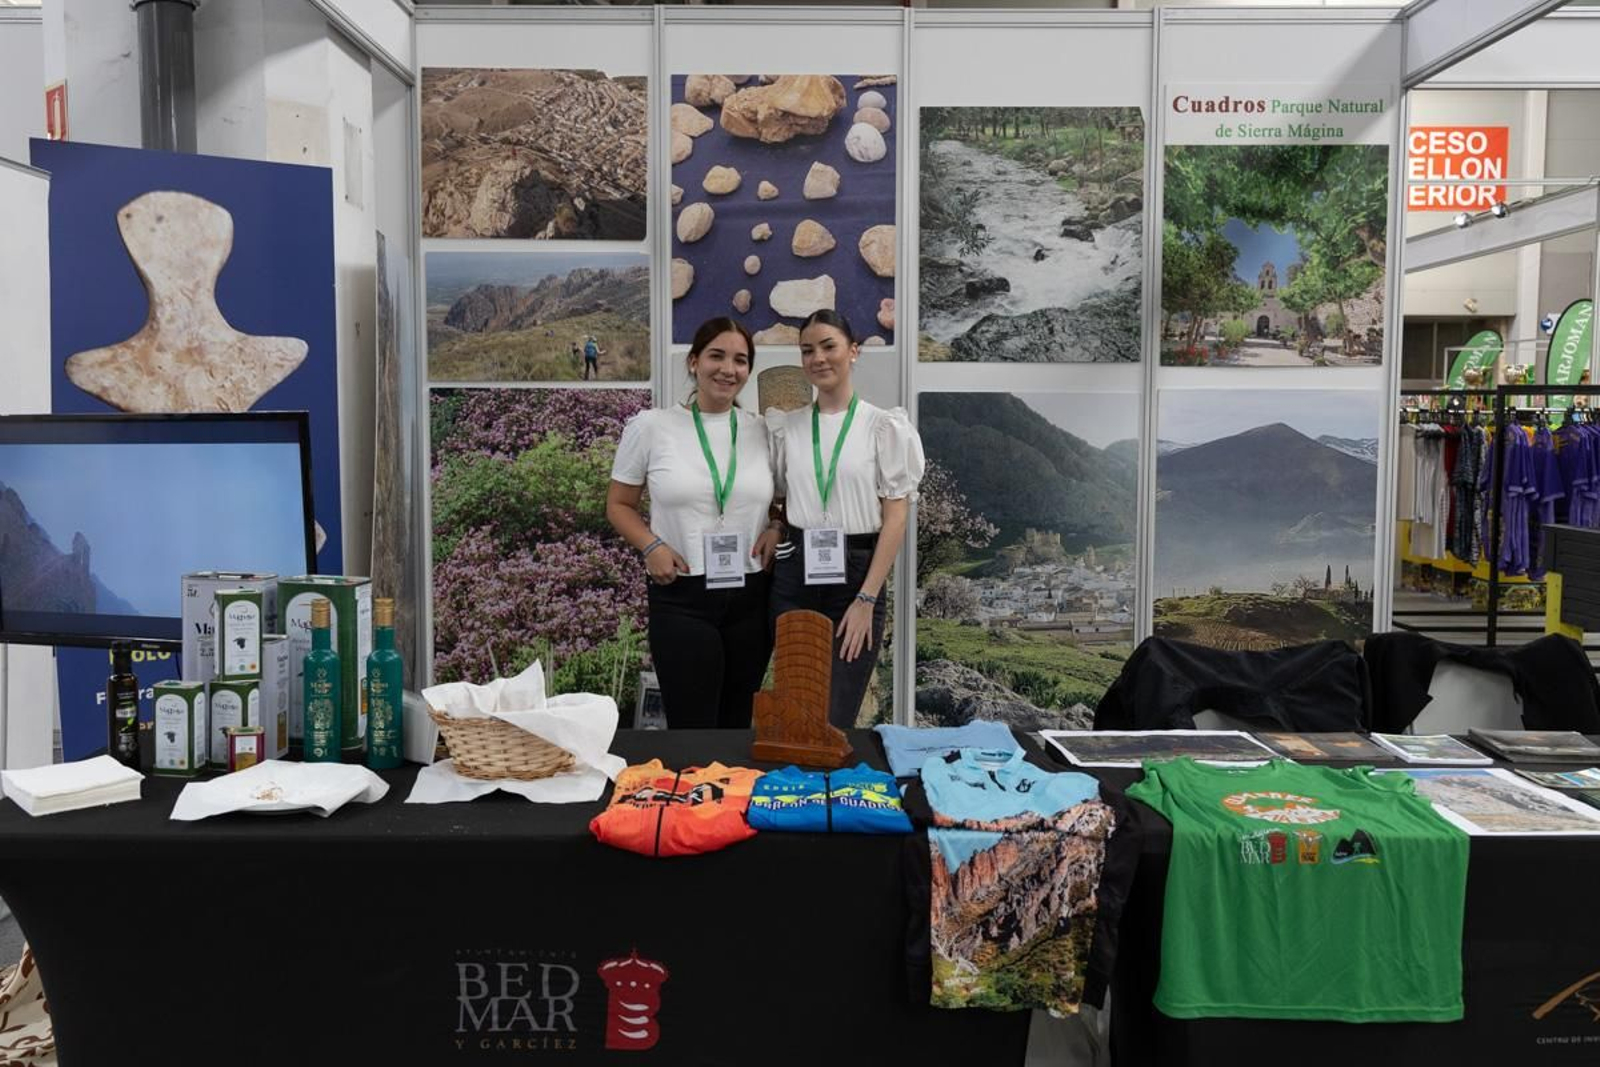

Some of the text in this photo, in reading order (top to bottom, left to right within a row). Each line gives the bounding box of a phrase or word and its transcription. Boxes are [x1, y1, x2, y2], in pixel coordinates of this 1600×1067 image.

[1172, 96, 1384, 117] Cuadros Parque Natural
[1215, 123, 1344, 141] de Sierra Mágina
[454, 962, 580, 1000] BED
[454, 998, 578, 1032] MAR
[455, 1039, 465, 1050] Y
